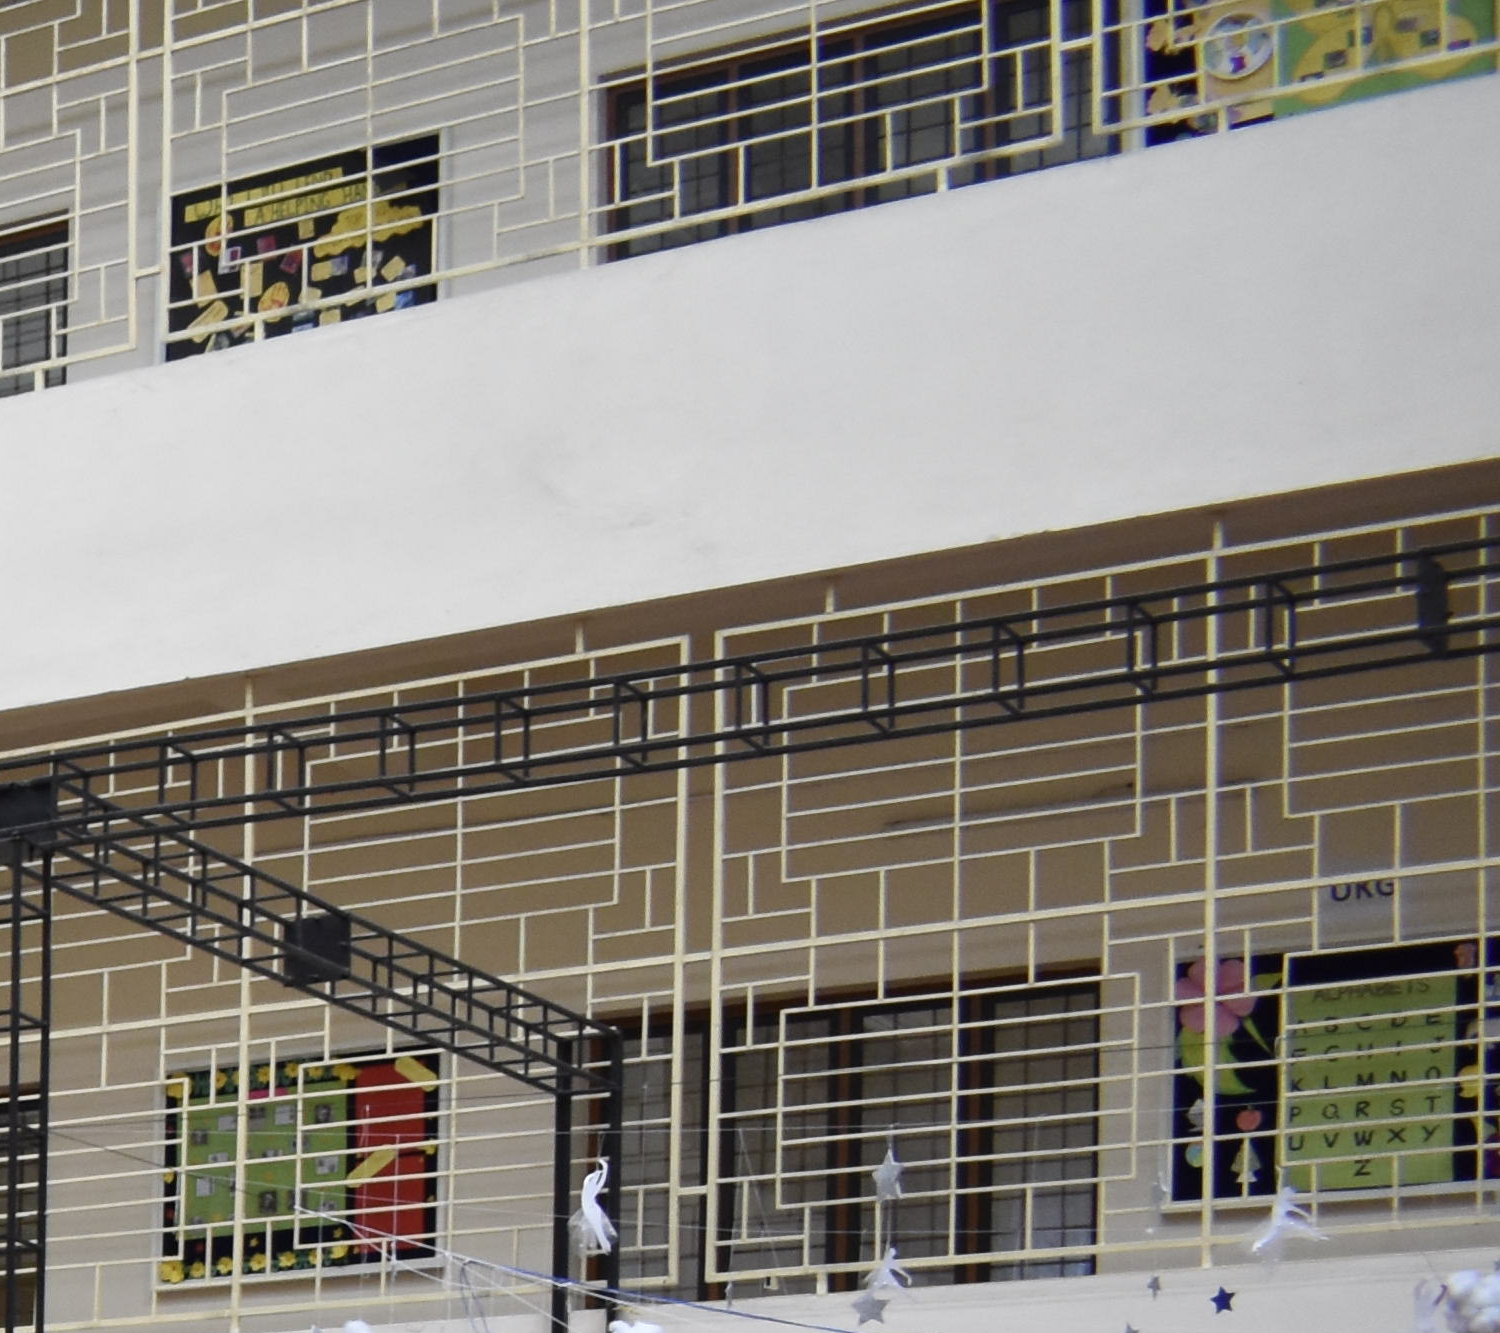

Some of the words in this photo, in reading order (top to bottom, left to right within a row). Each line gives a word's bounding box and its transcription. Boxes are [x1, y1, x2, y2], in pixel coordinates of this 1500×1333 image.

[1356, 1072, 1374, 1086] M
[1390, 1069, 1407, 1083] N
[1289, 1106, 1302, 1122] P
[1322, 1103, 1340, 1119] Q
[1355, 1101, 1370, 1118] R
[1390, 1098, 1405, 1116] S
[1425, 1096, 1441, 1113] T
[1288, 1134, 1304, 1151] U
[1323, 1132, 1339, 1148] V
[1354, 1129, 1375, 1146] W
[1387, 1127, 1406, 1143] X
[1422, 1123, 1440, 1142] Y
[1354, 1158, 1371, 1177] Z
